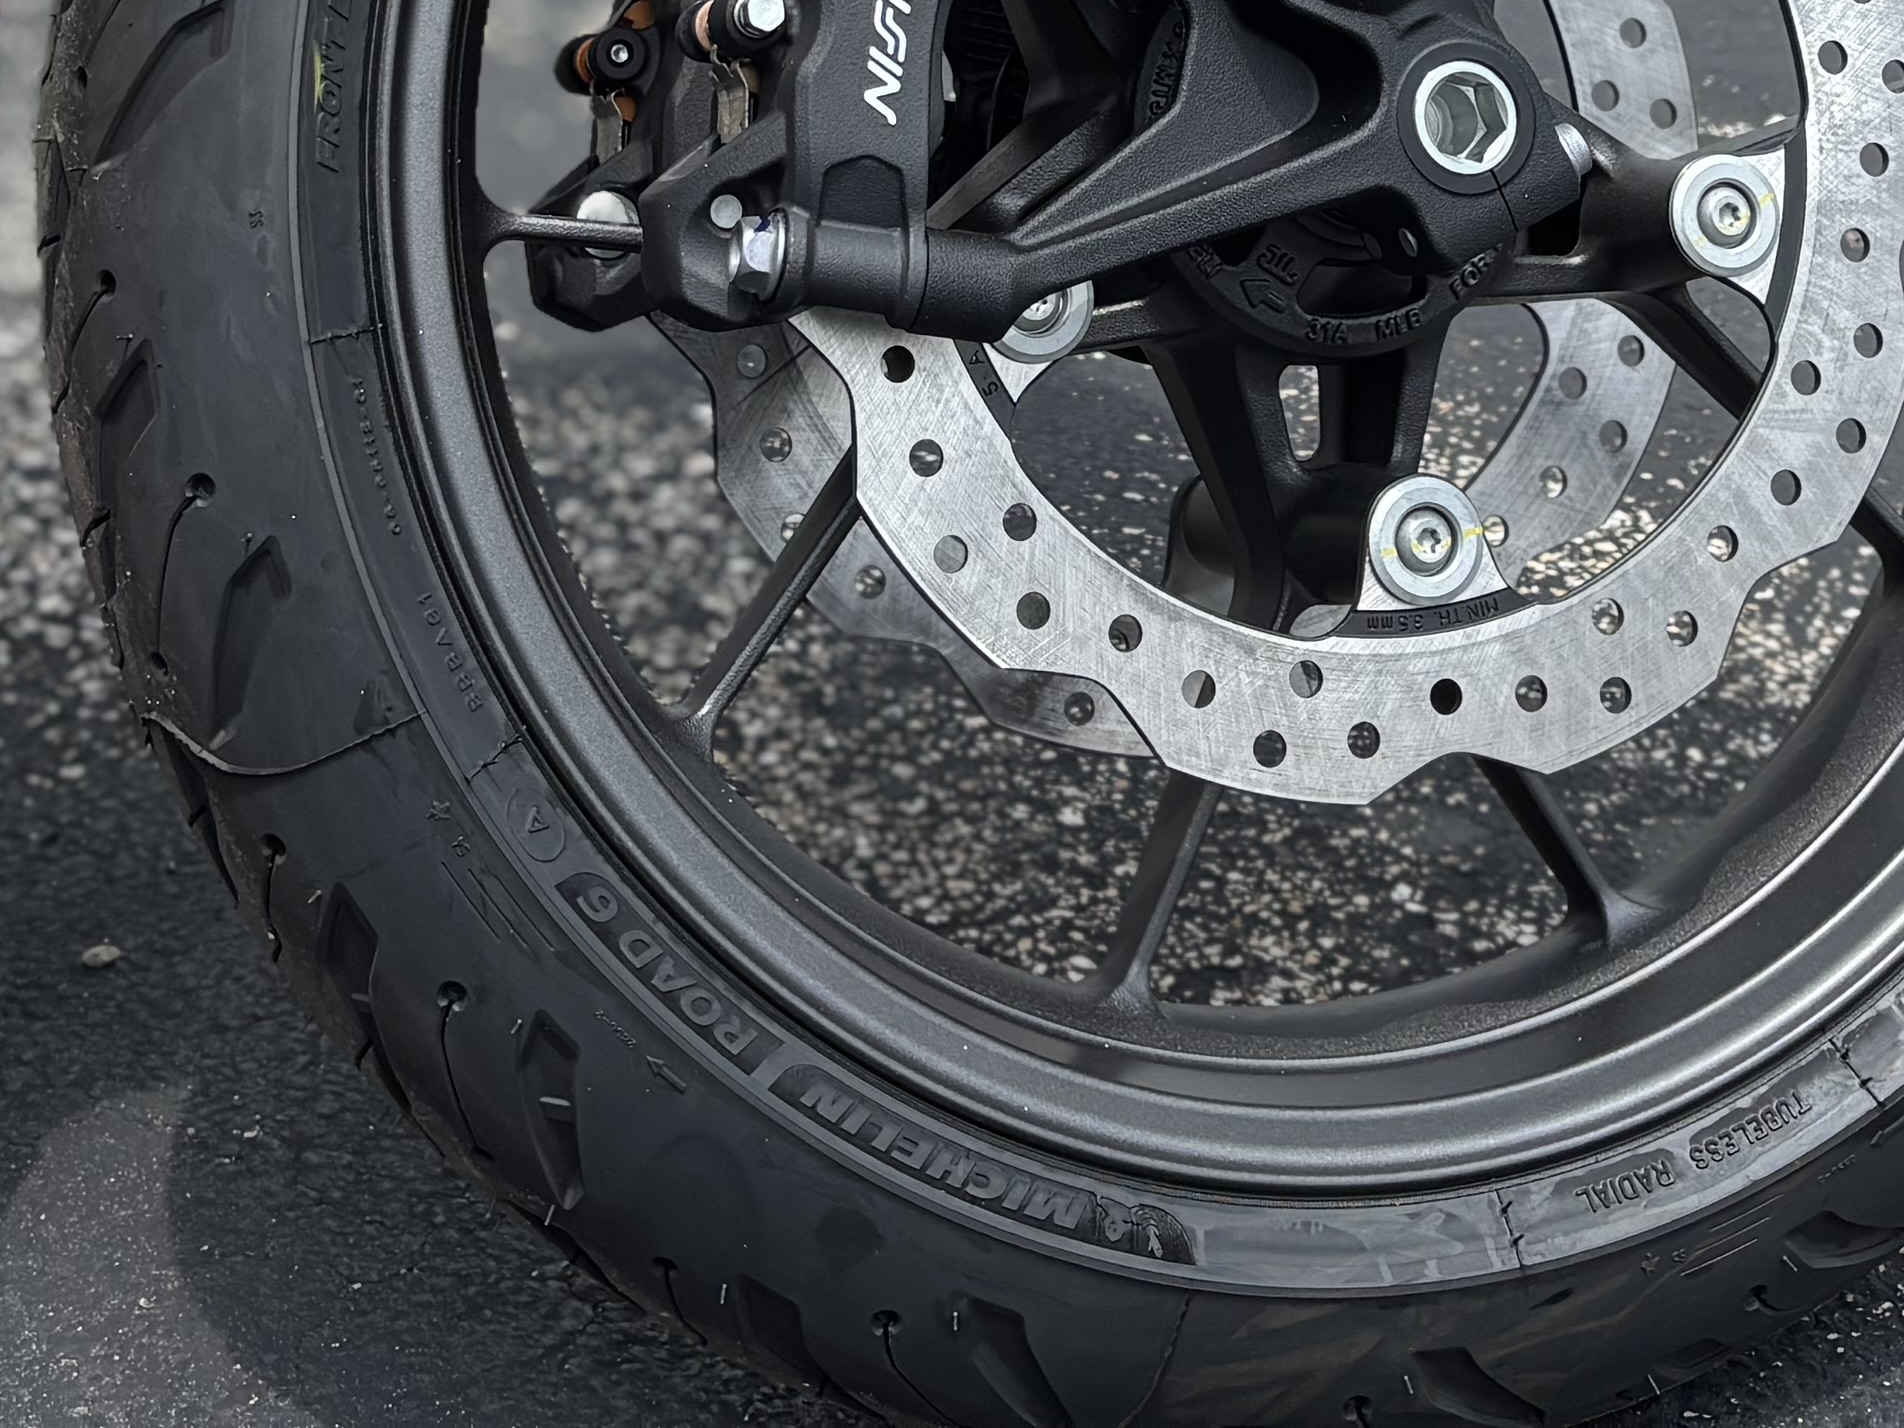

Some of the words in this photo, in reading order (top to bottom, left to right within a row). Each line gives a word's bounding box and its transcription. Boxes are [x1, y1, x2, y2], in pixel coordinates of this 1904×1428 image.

[576, 885, 620, 924] 6
[618, 928, 760, 1058] ROAD
[798, 1081, 1089, 1232] MICHELIN
[1688, 1086, 1814, 1171] TUBELESS
[1574, 1156, 1676, 1215] RADIAL
